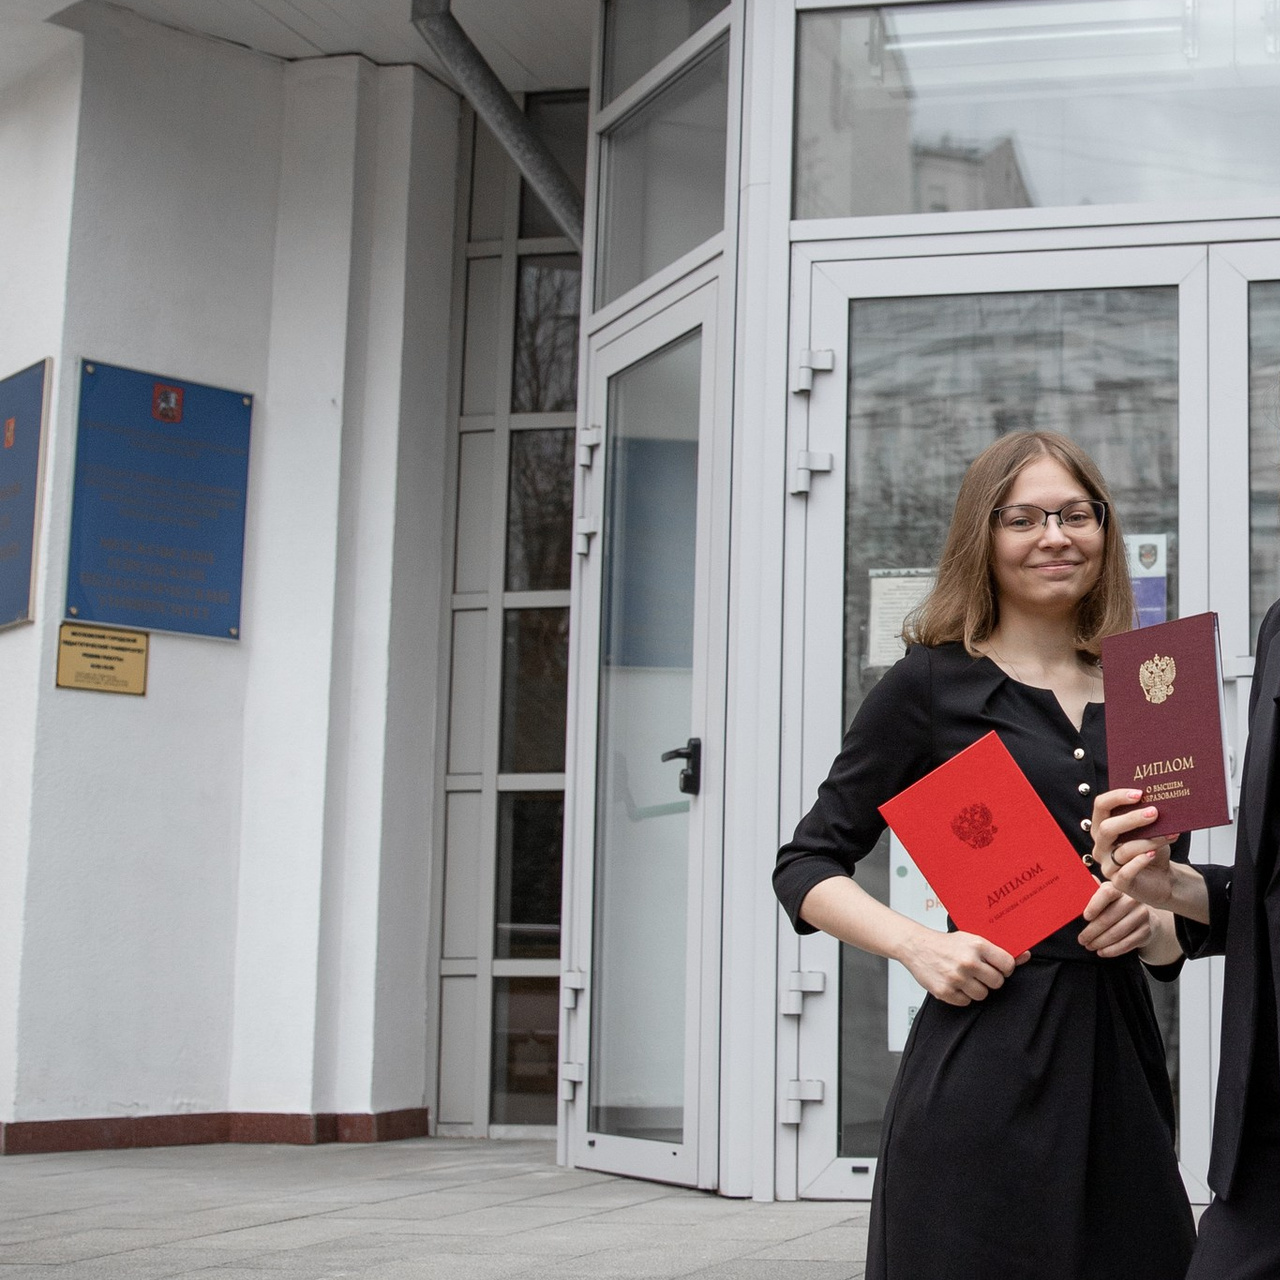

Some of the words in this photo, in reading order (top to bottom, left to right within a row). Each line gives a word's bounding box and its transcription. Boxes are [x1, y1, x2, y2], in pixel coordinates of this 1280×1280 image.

[1133, 755, 1195, 781] ДИПЛОМ
[1146, 785, 1152, 794] О
[1153, 780, 1184, 792] ВЫСШЕМ
[986, 862, 1045, 908] ДИПЛОМ
